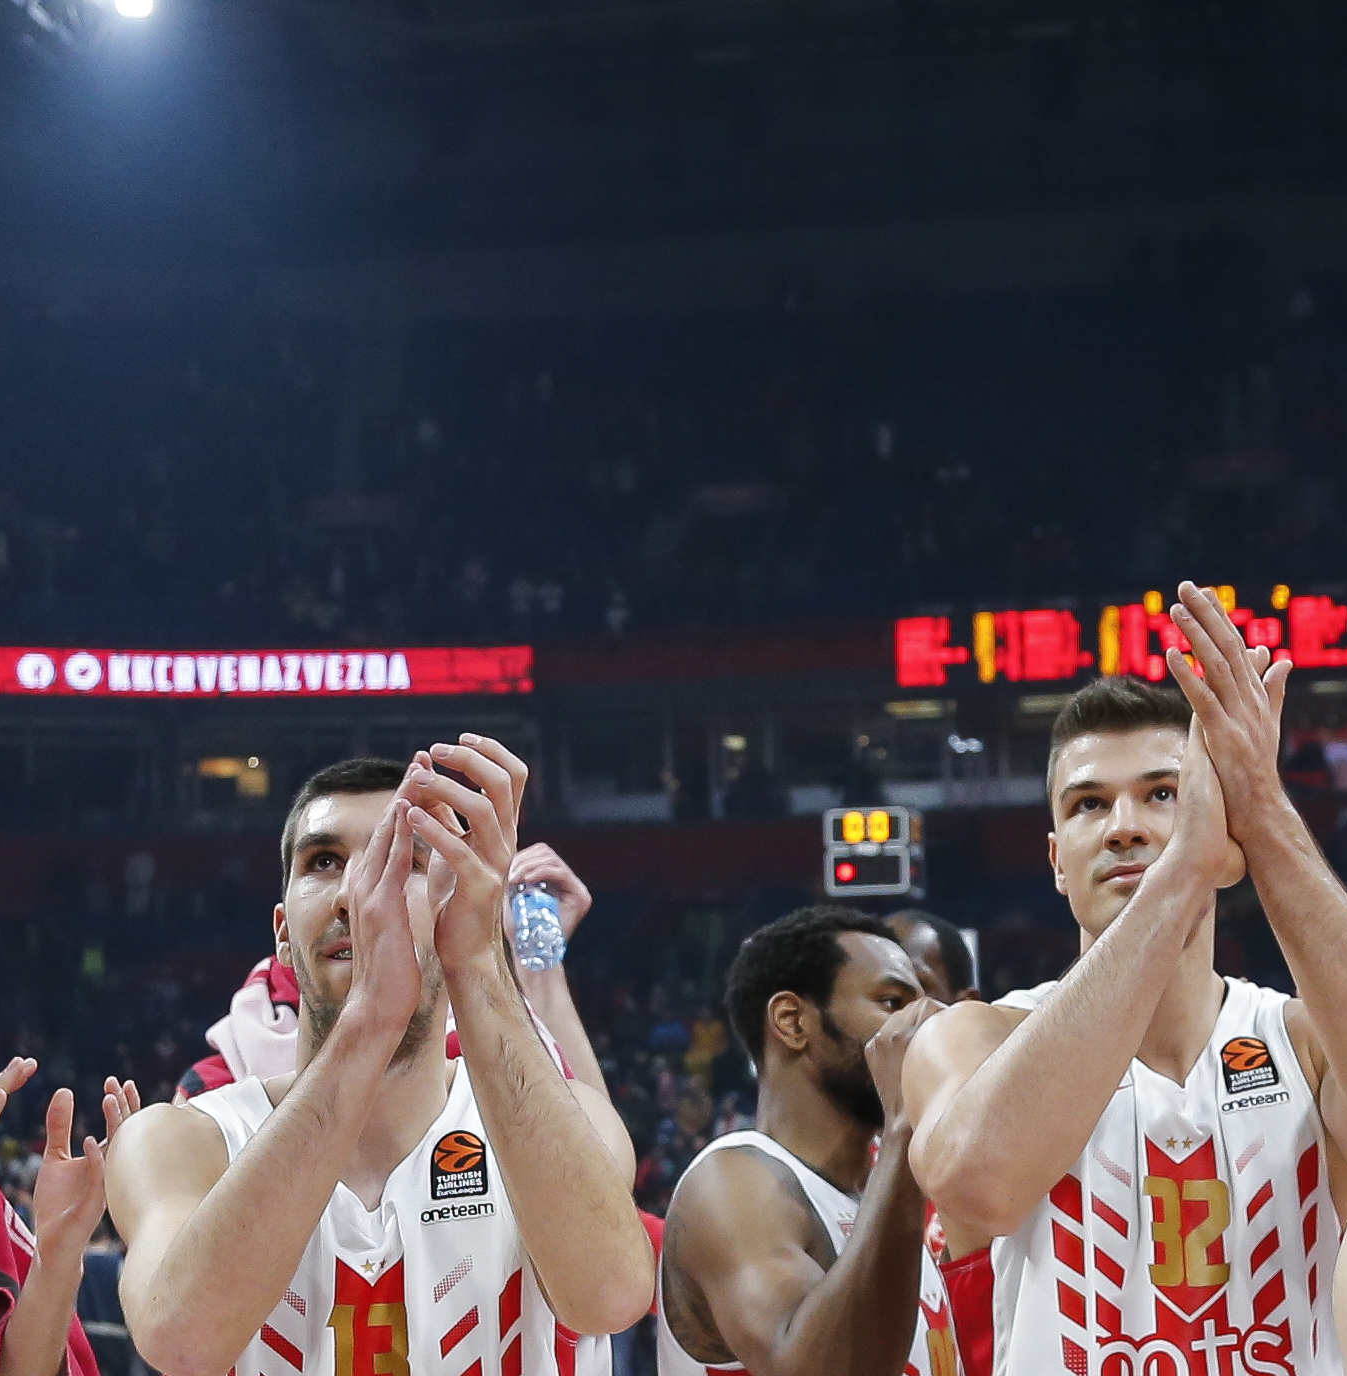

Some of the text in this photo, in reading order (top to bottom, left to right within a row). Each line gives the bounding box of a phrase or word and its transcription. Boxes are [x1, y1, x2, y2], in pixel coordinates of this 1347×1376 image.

[108, 653, 411, 692] KKCRVENAZVEZDA
[437, 1170, 482, 1183] TURKISH
[437, 1178, 483, 1190] AIRLINES
[1144, 1176, 1231, 1287] 32
